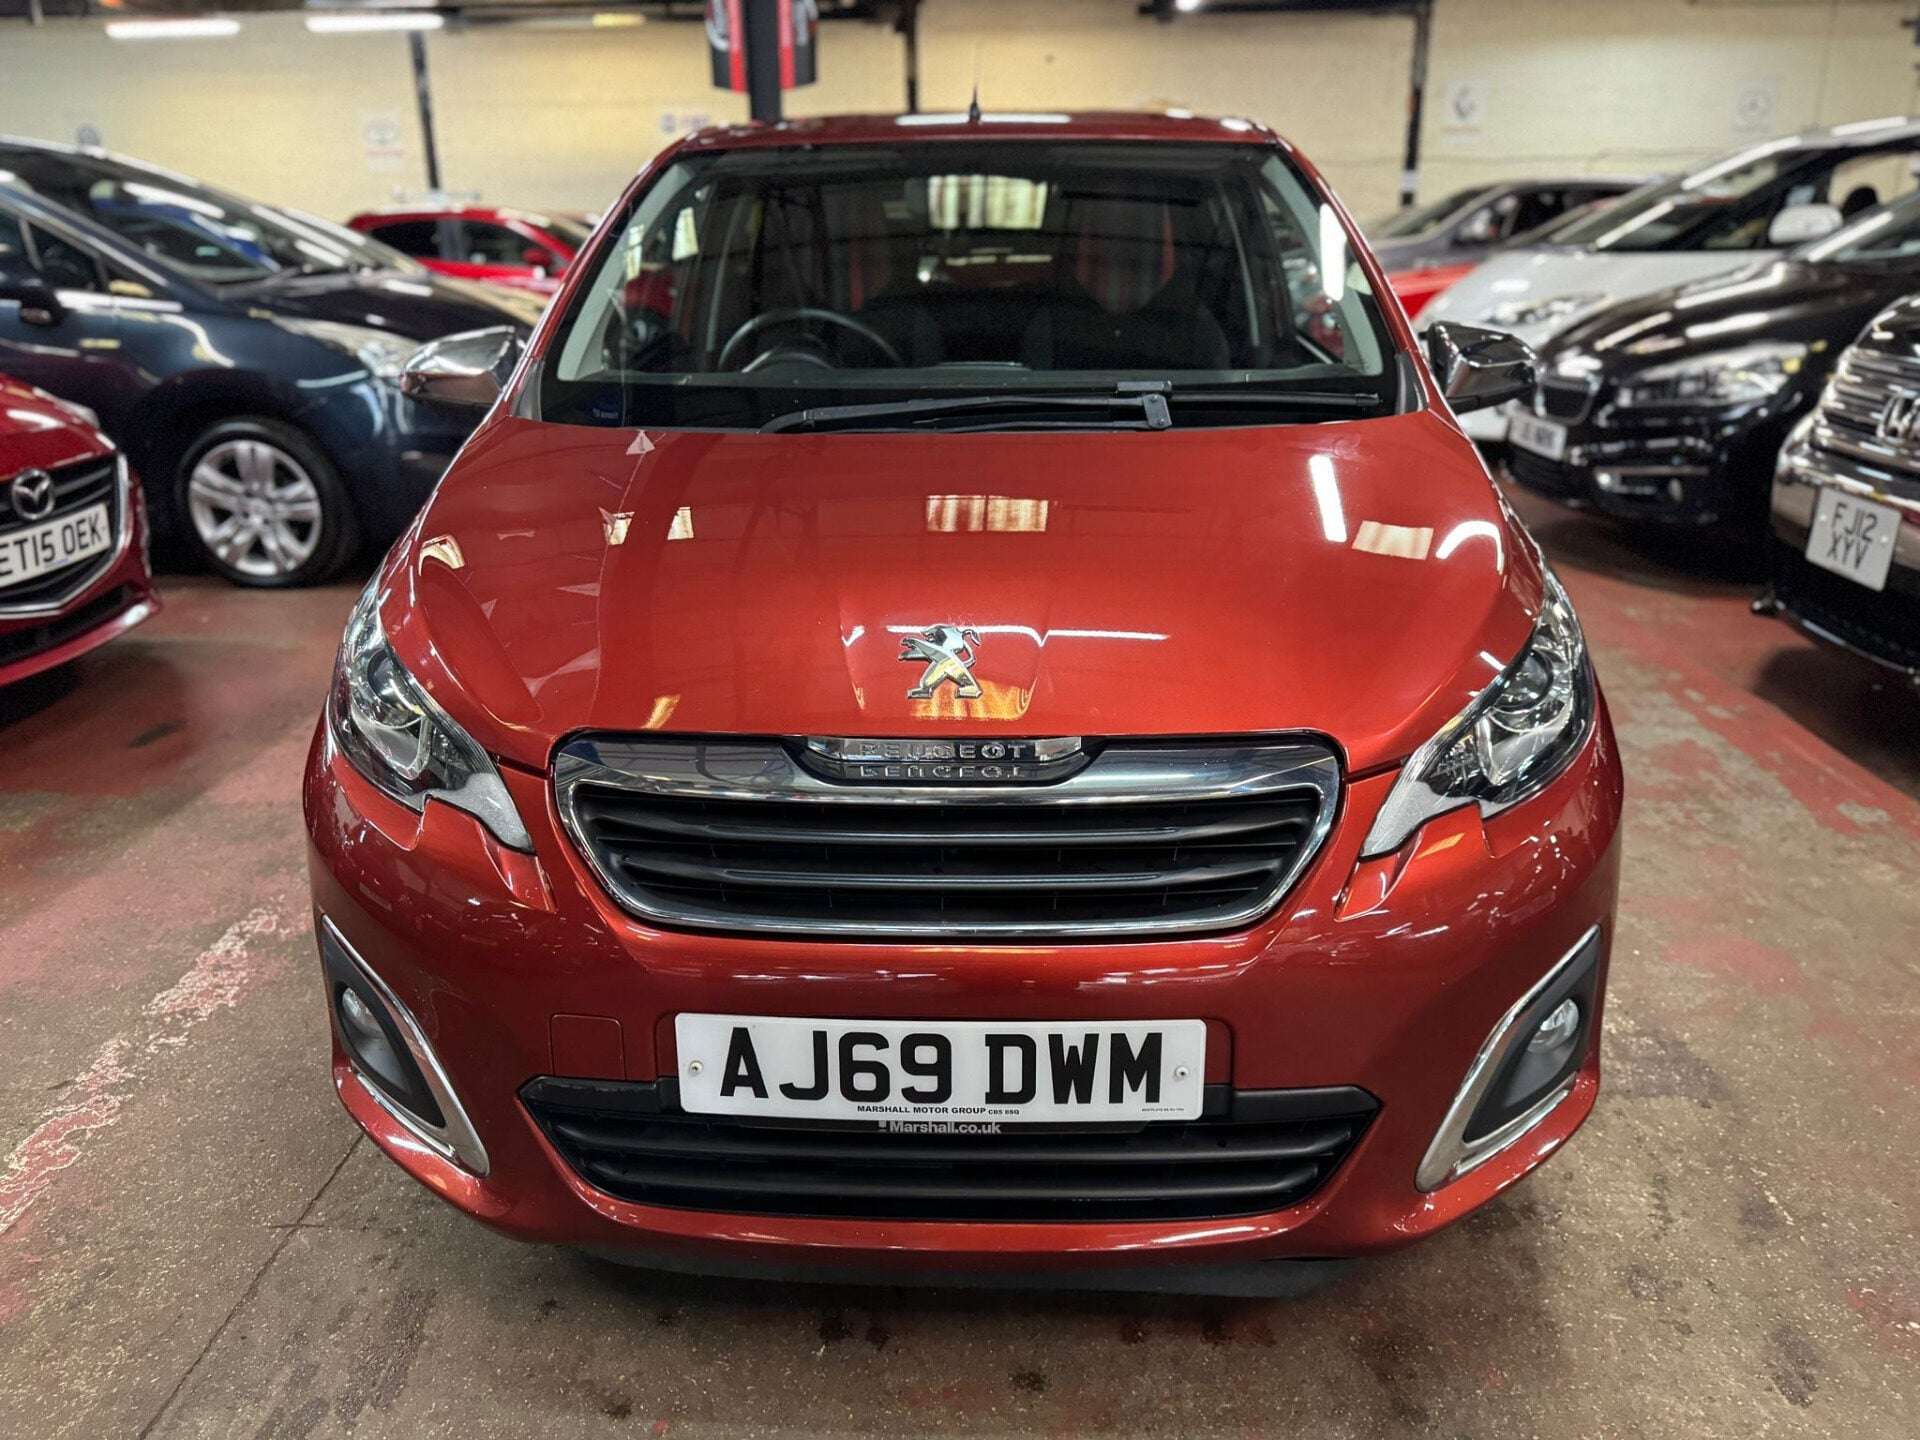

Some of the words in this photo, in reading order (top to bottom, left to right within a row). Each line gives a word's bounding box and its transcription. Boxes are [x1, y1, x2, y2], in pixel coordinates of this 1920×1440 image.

[62, 513, 102, 556] OEK
[1831, 502, 1878, 542] FJ12
[1826, 531, 1869, 570] XYV
[860, 743, 1026, 760] PEUGEOT
[719, 1026, 952, 1102] AJ69
[985, 1032, 1163, 1105] DWM
[857, 1105, 910, 1114] MARSHALL
[913, 1106, 949, 1115] MOTOR
[951, 1107, 986, 1115] GROUP
[889, 1120, 1001, 1134] Marshall.co.uk
